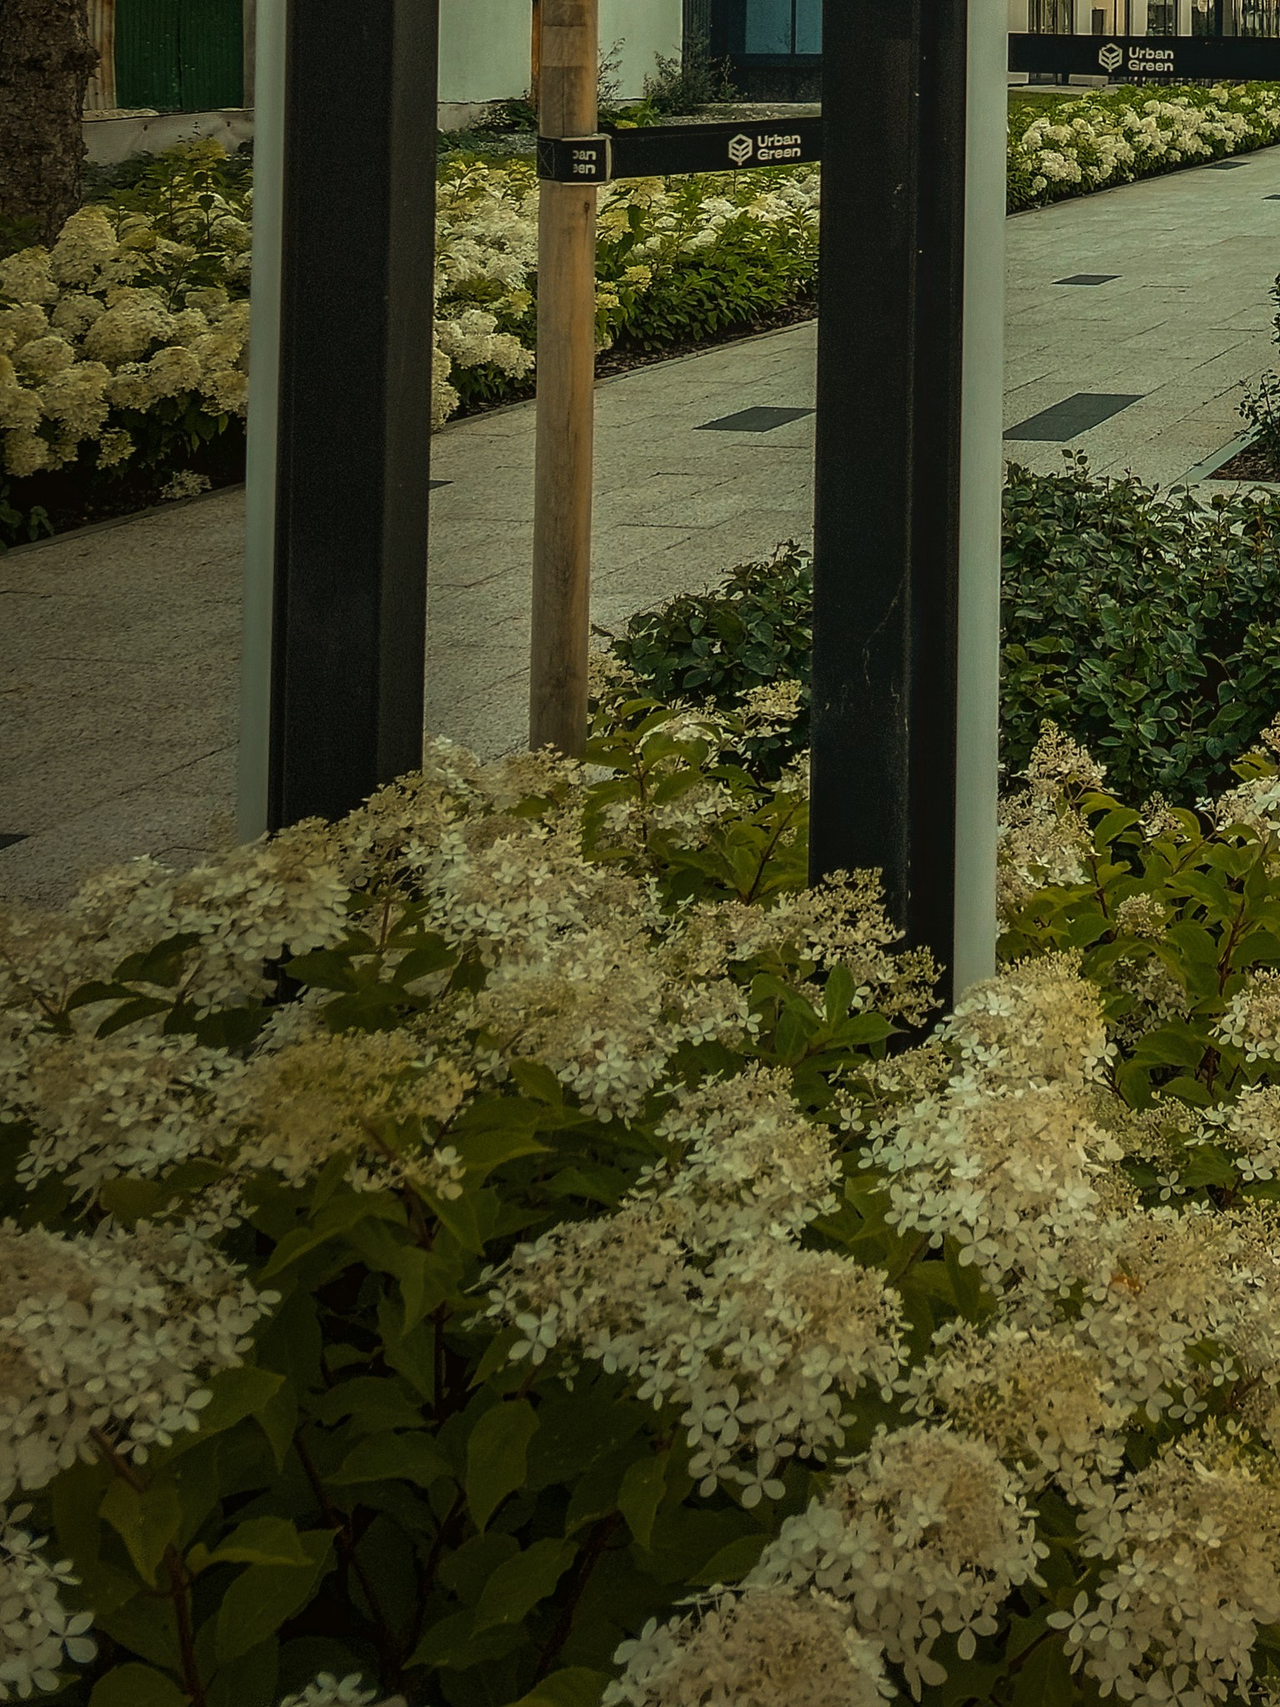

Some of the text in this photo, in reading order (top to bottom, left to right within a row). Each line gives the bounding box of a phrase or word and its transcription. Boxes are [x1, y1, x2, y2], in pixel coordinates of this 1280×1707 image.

[1128, 47, 1174, 59] Urban
[1128, 59, 1174, 72] Green
[757, 134, 801, 147] Urban
[757, 147, 801, 161] Green
